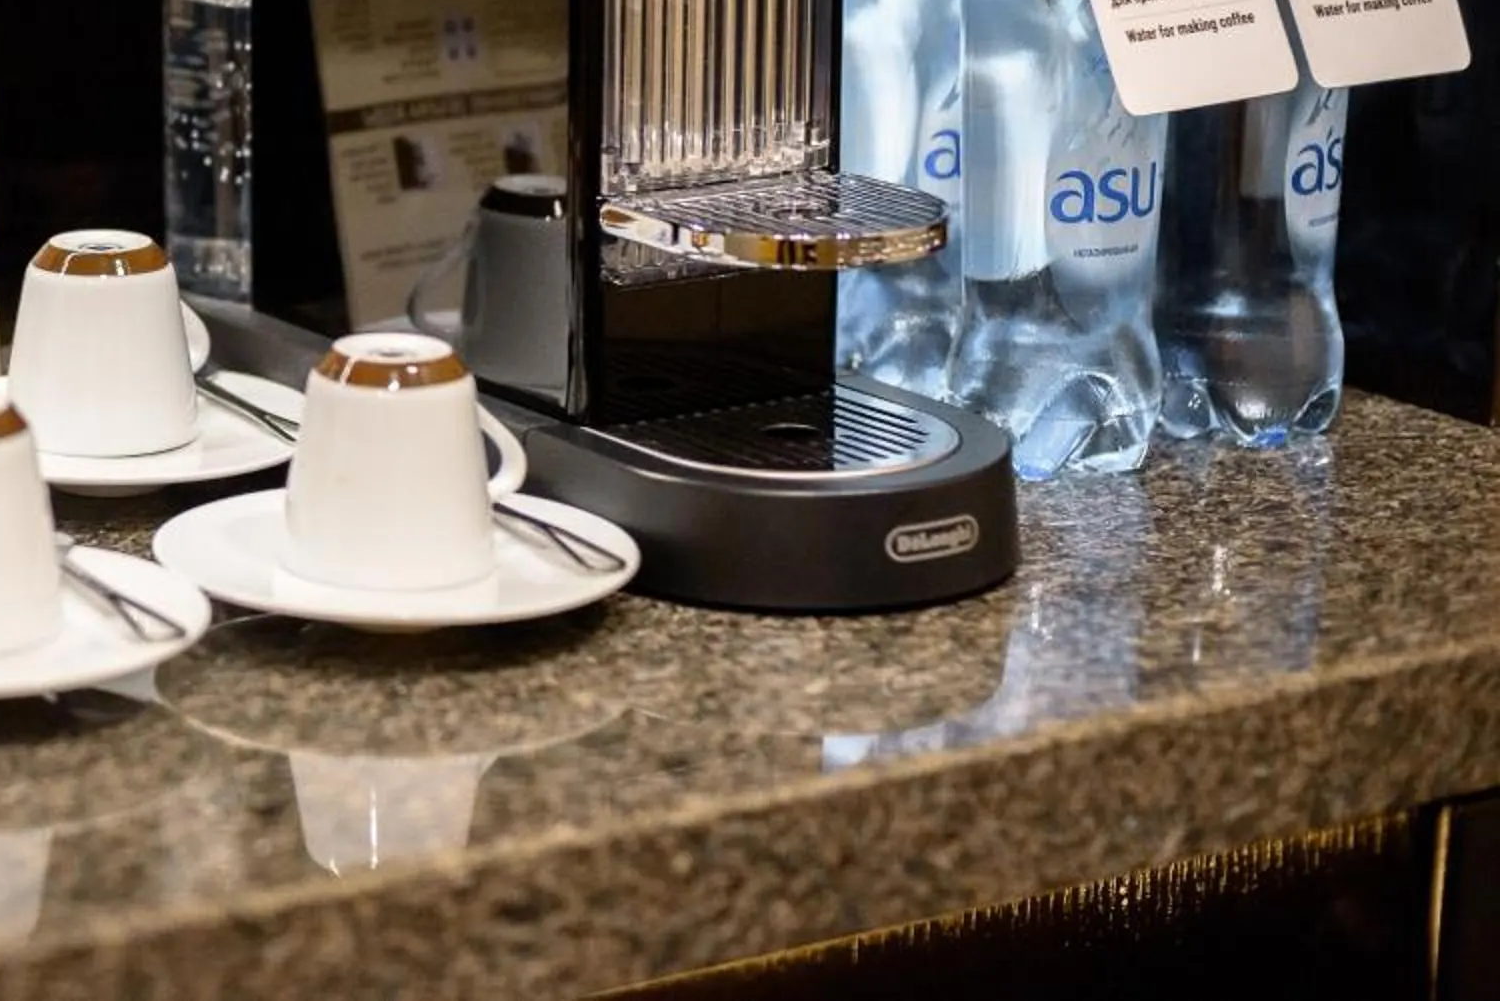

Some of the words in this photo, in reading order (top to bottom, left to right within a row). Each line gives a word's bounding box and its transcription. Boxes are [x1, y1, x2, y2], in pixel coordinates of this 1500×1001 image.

[1313, 4, 1344, 17] Water
[1345, 0, 1362, 13] for
[1125, 29, 1157, 43] Water
[1159, 23, 1175, 38] for
[1177, 17, 1219, 36] making
[1219, 11, 1256, 29] coffee
[1050, 162, 1157, 224] asu
